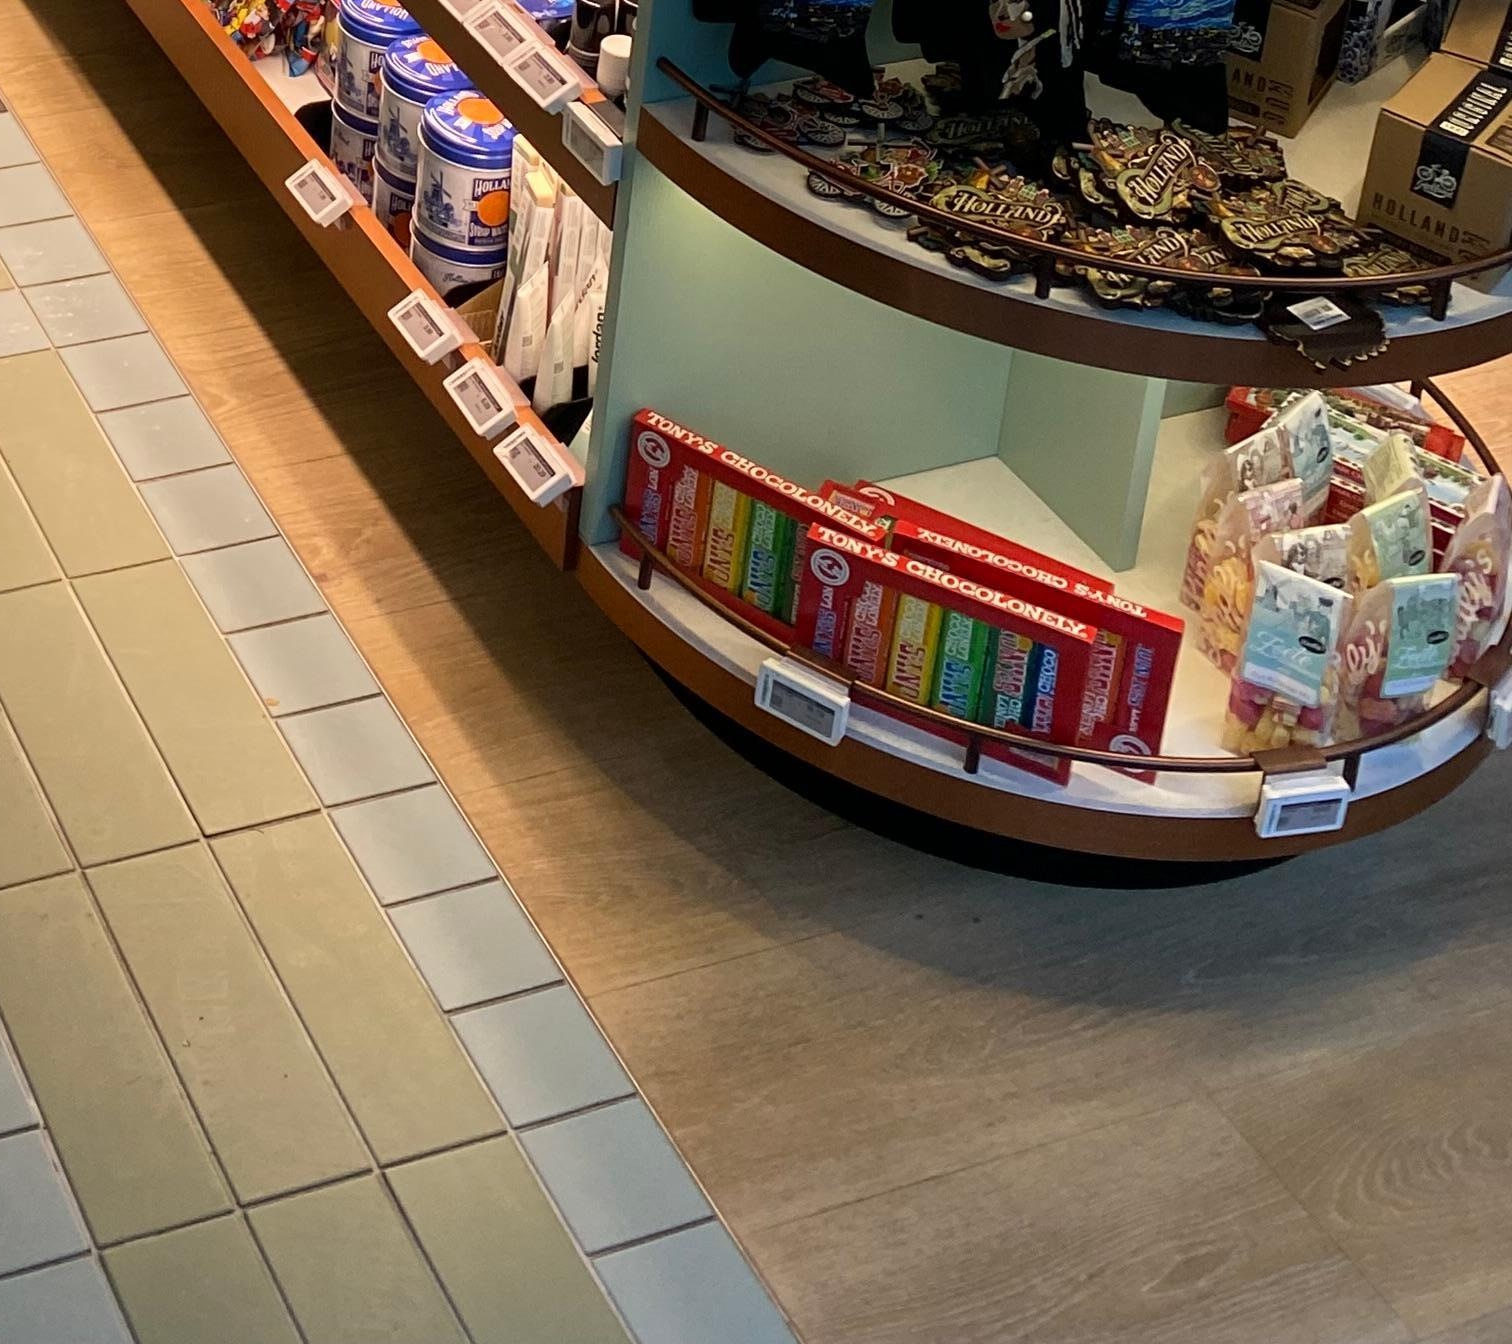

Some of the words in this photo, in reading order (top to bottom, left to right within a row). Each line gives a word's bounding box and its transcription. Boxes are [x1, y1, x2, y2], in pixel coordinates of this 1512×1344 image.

[1448, 81, 1508, 130] ORIGINAL
[473, 178, 512, 198] HOLLA
[1130, 140, 1189, 206] HOLLAND
[950, 191, 1054, 225] HOLLAND
[1239, 212, 1314, 244] HOLLAND
[1372, 191, 1461, 245] HOLLAND
[646, 411, 719, 455] TONY'S
[720, 450, 879, 539] CHOCOLONELY
[817, 526, 901, 568] TONY'S
[905, 560, 1090, 640] CHOCOLONELY
[917, 526, 1069, 590] CHOCOLONELY
[1073, 582, 1148, 619] TONY'S
